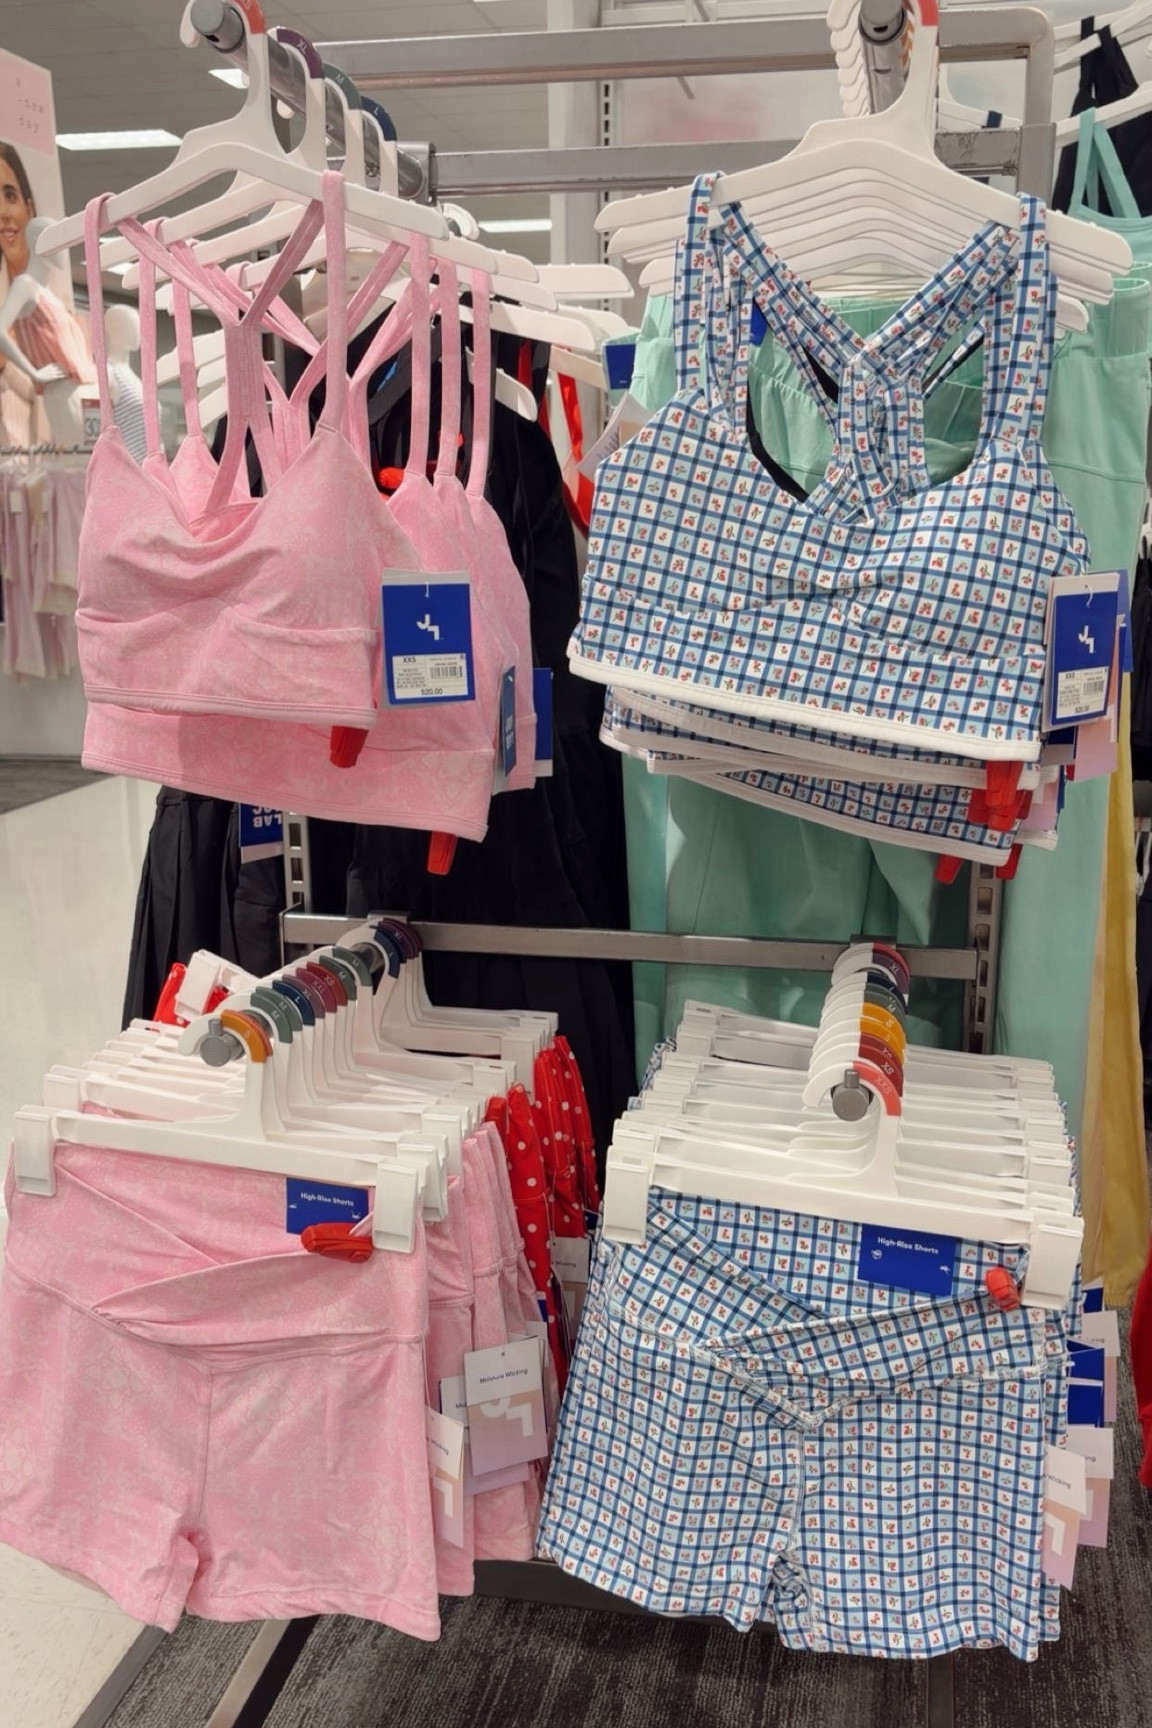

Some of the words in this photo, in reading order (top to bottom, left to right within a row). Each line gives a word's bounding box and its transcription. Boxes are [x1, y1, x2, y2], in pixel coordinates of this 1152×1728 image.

[300, 1192, 332, 1204] High-Rise
[333, 1197, 354, 1207] Shorts
[877, 1236, 913, 1250] High-Rise
[914, 1243, 939, 1255] Shorts
[480, 1373, 504, 1383] Moisture
[505, 1368, 528, 1378] Wicking
